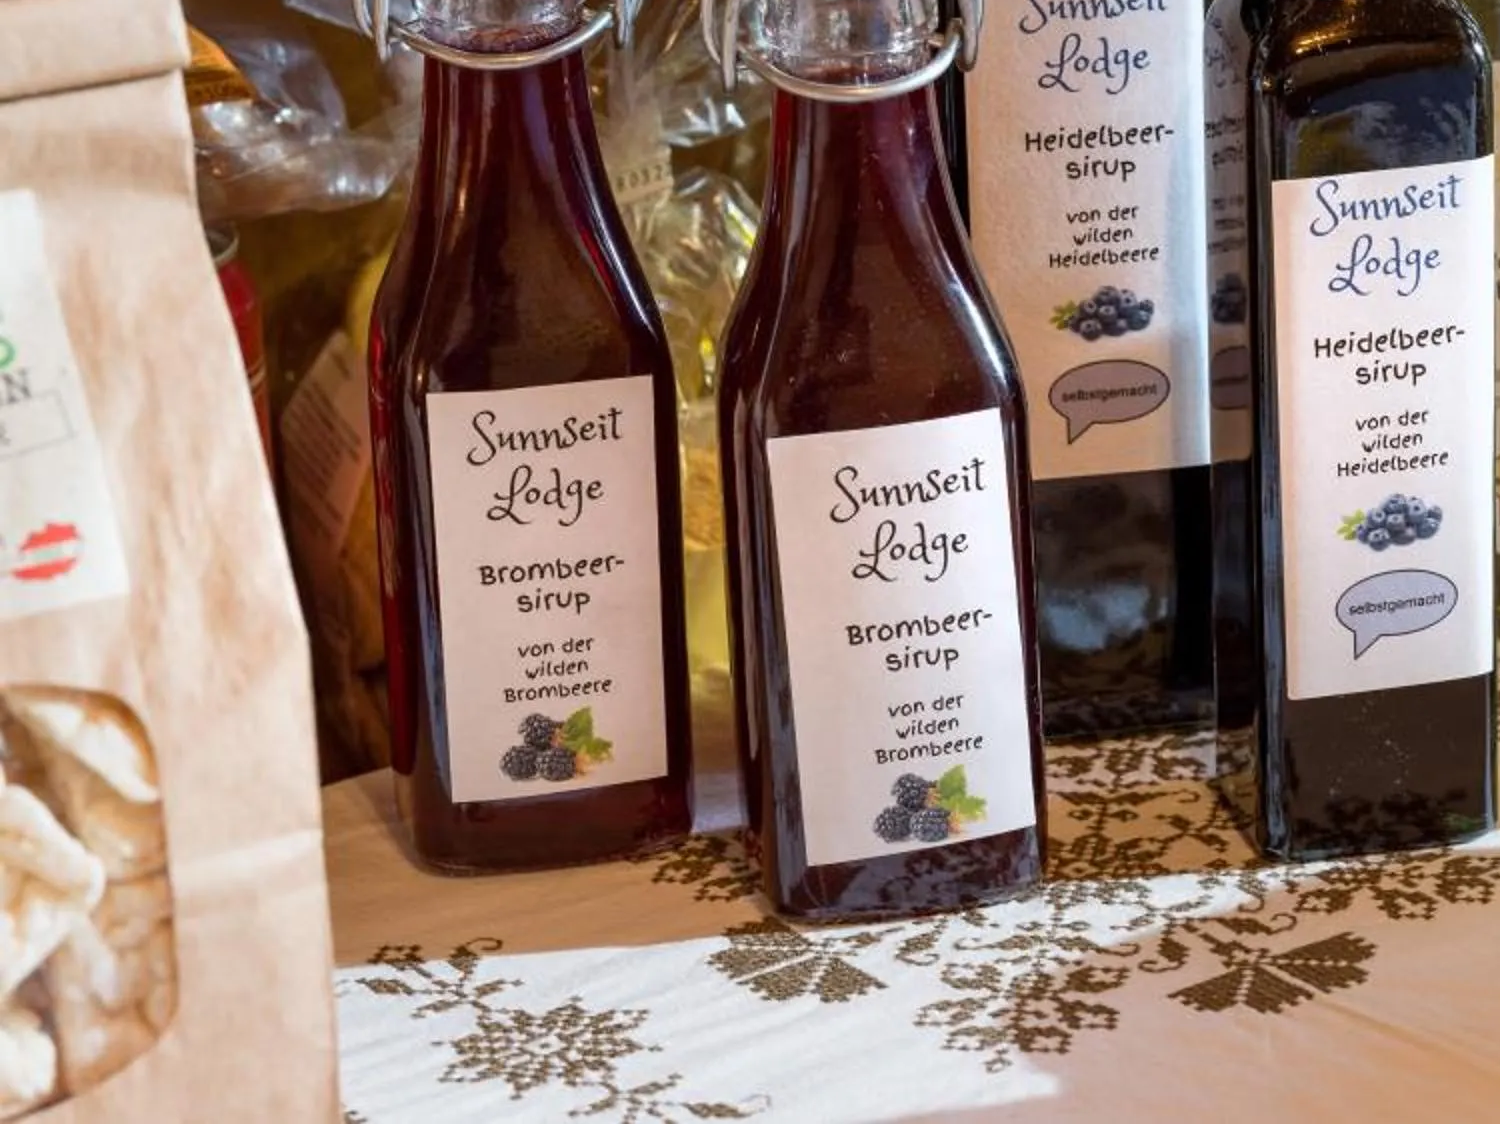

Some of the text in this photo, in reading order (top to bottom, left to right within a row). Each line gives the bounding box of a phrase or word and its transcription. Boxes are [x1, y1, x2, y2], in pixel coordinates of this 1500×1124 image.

[1038, 33, 1150, 94] Lodge
[1025, 123, 1174, 153] Heidelbeer-
[1066, 155, 1136, 181] sirup
[1067, 204, 1137, 223] von der
[1073, 227, 1133, 245] wilden
[1049, 245, 1159, 269] Heidelbeere
[1329, 234, 1441, 296] Lodge
[1315, 322, 1465, 360] Heidelbeer-
[1356, 360, 1426, 387] sirup
[1061, 381, 1158, 404] selbstgemacht
[1355, 408, 1429, 431] von der
[1362, 431, 1423, 453] wilden
[1337, 450, 1449, 477] Heidelbeere
[488, 465, 604, 526] Lodge
[852, 520, 968, 582] Lodge
[479, 555, 624, 585] Brombeer-
[517, 587, 590, 614] sirup
[1349, 591, 1445, 618] selbstgemacht
[847, 609, 992, 646] Brombeer-
[518, 636, 594, 658] von der
[885, 646, 959, 672] sirup
[525, 660, 588, 679] wilden
[504, 678, 612, 703] Brombeere
[888, 694, 964, 718] von der
[895, 717, 959, 739] wilden
[875, 735, 983, 765] Brombeere
